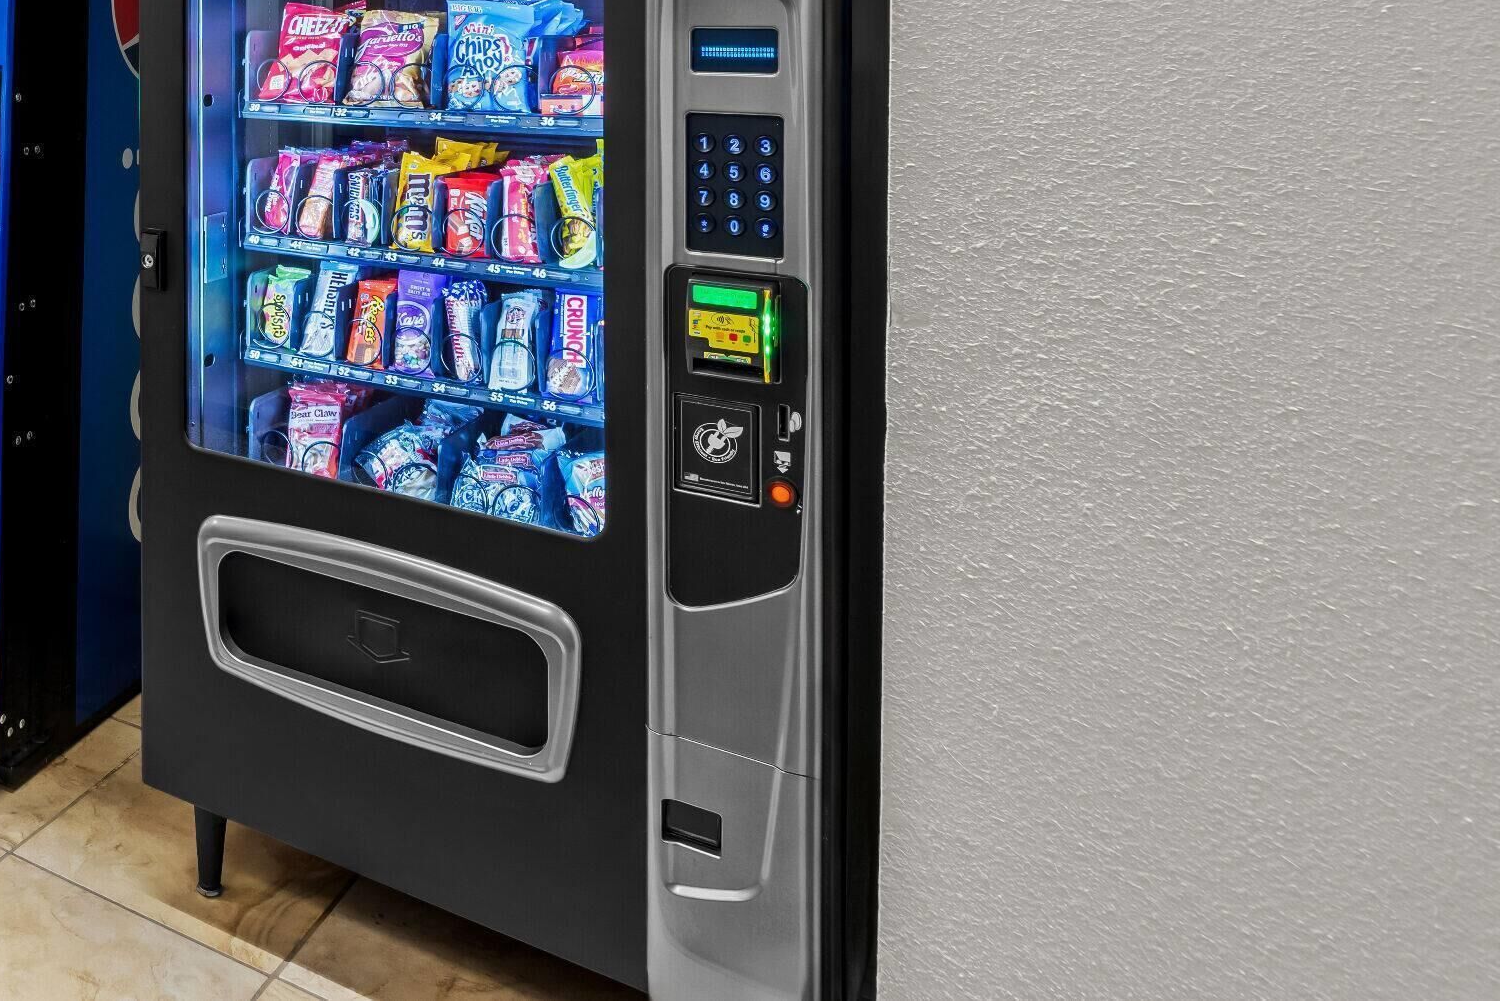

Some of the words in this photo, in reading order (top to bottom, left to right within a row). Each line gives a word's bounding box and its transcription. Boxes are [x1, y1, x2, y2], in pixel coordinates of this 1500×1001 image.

[456, 36, 501, 64] Chips
[248, 103, 261, 112] 30
[335, 108, 348, 117] 32
[429, 113, 442, 122] 34
[541, 117, 555, 126] 36
[700, 136, 707, 150] 1
[729, 138, 740, 152] 2
[760, 139, 771, 153] 3
[699, 162, 709, 176] 4
[729, 165, 739, 179] 5
[760, 167, 771, 180] 6
[554, 165, 585, 217] Butterfinger
[699, 190, 708, 204] 7
[729, 192, 739, 206] 8
[760, 194, 771, 208] 9
[730, 220, 739, 233] 0
[348, 248, 361, 257] 42
[385, 253, 397, 262] 43
[432, 258, 445, 268] 44
[488, 264, 501, 274] 45
[532, 269, 547, 278] 46
[566, 296, 585, 369] CRUNCH
[491, 391, 504, 401] 55
[542, 400, 557, 410] 56
[291, 410, 311, 419] Bear
[314, 409, 337, 418] Claw
